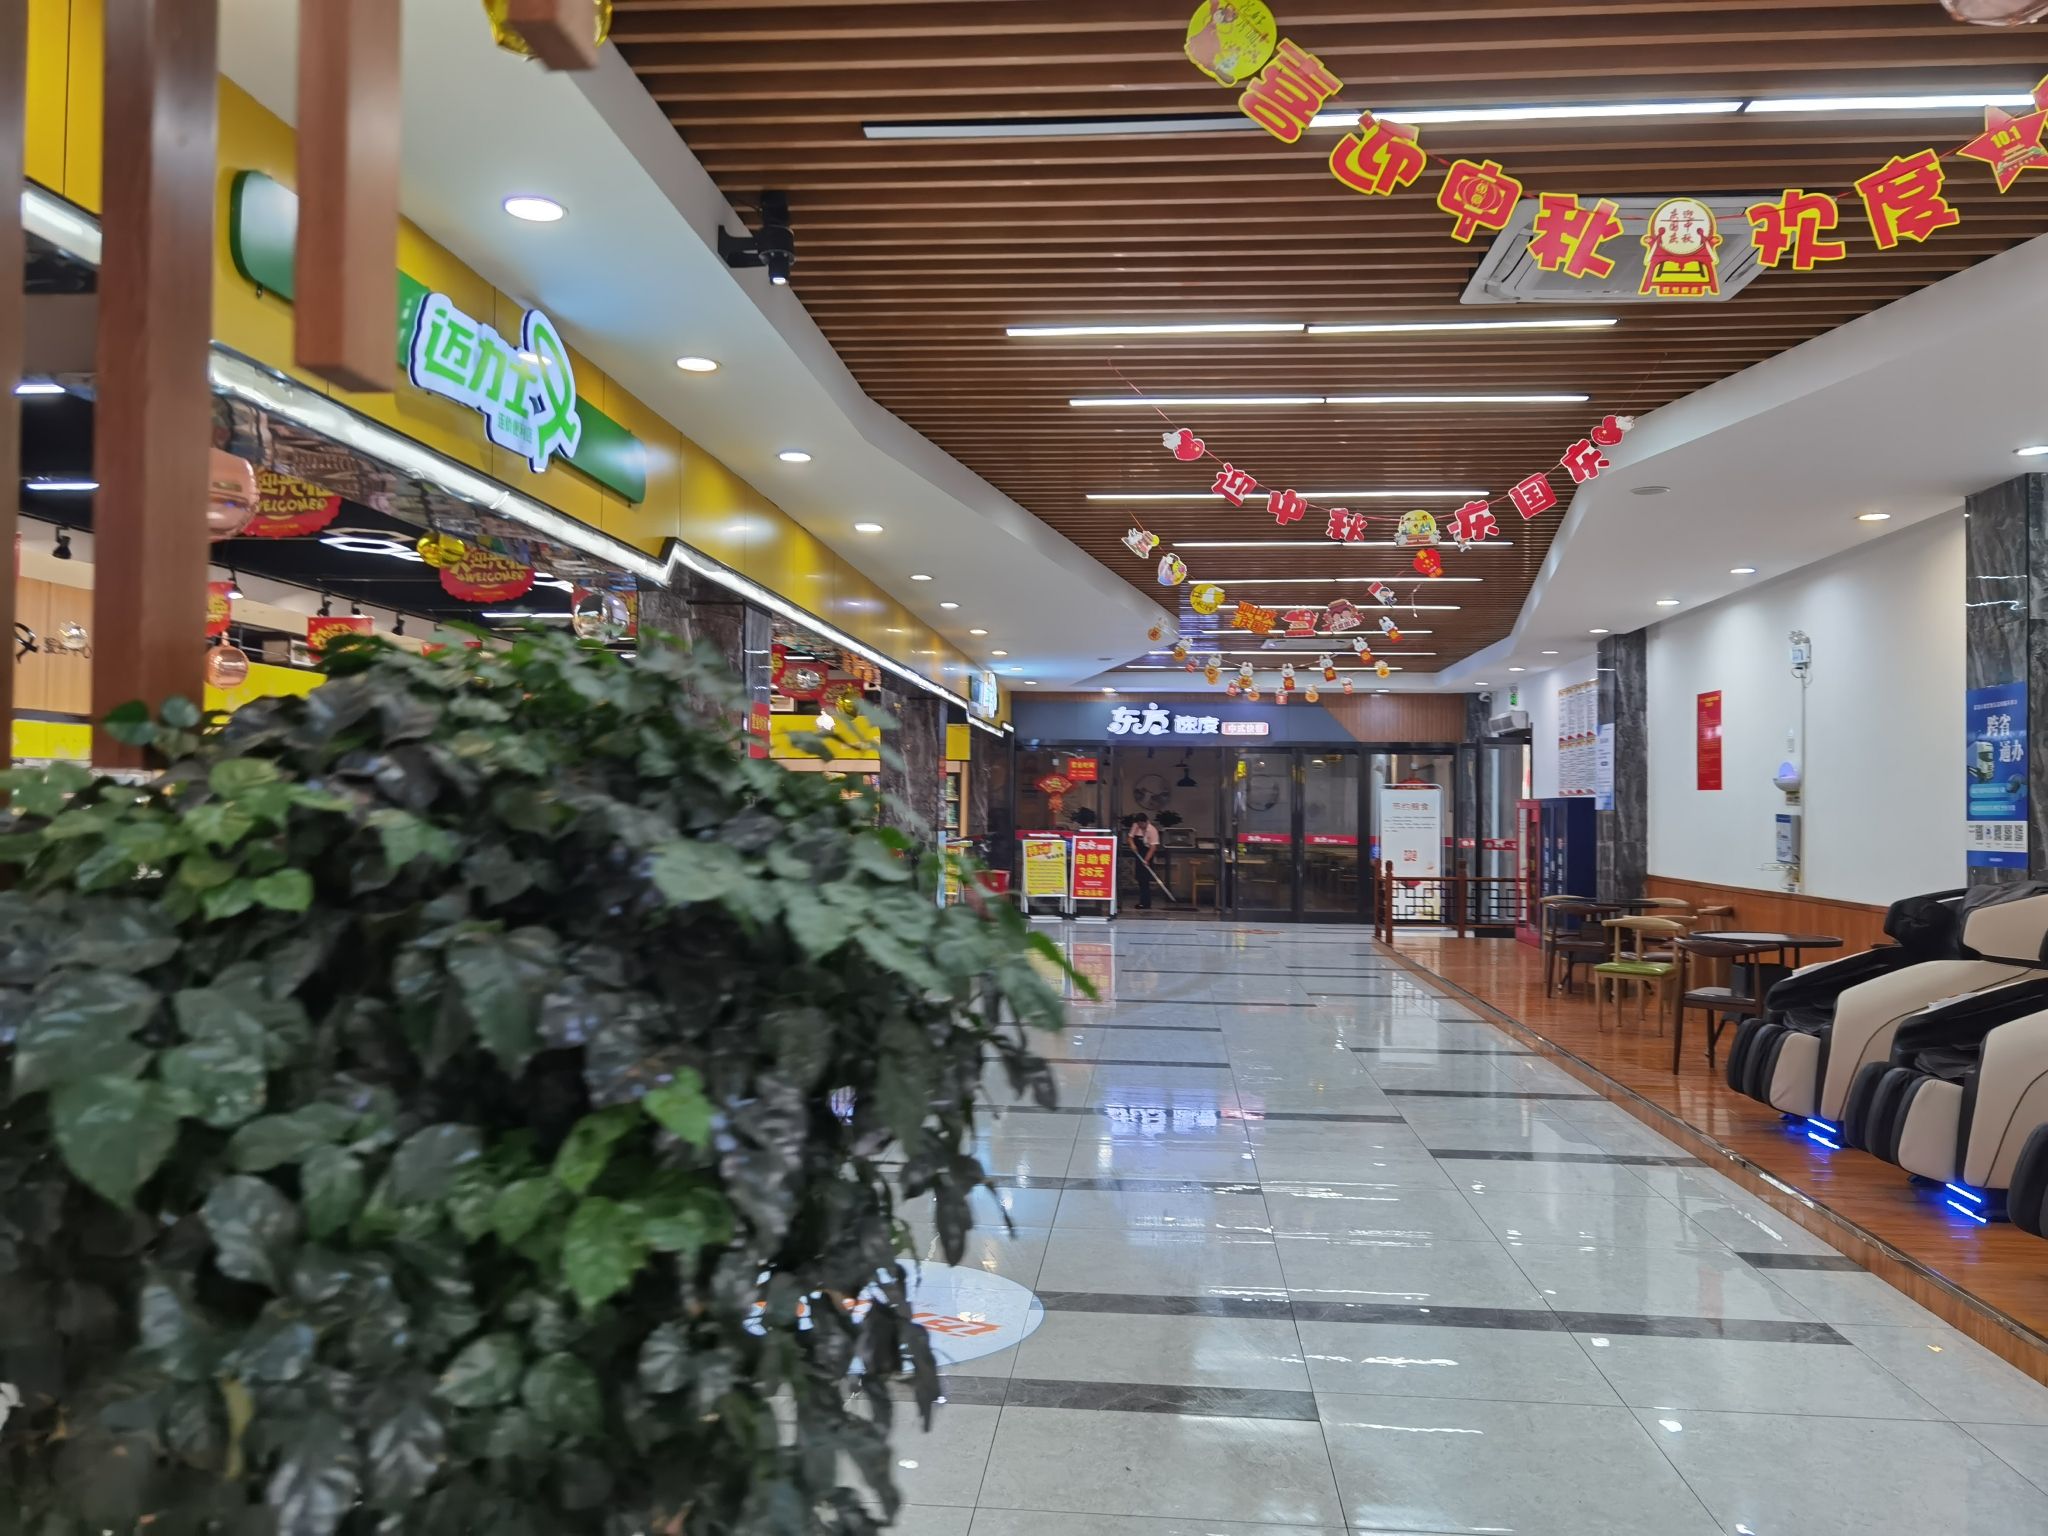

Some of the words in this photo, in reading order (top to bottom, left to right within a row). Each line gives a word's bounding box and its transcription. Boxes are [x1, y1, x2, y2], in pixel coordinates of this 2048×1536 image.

[1991, 126, 2022, 149] 10.1
[1745, 148, 1960, 270] 欢度
[424, 308, 538, 420] 迈力士
[1986, 714, 2012, 737] 跨省
[1999, 740, 2024, 763] 通办
[1075, 853, 1111, 865] 自助餐
[1078, 866, 1105, 878] 38元
